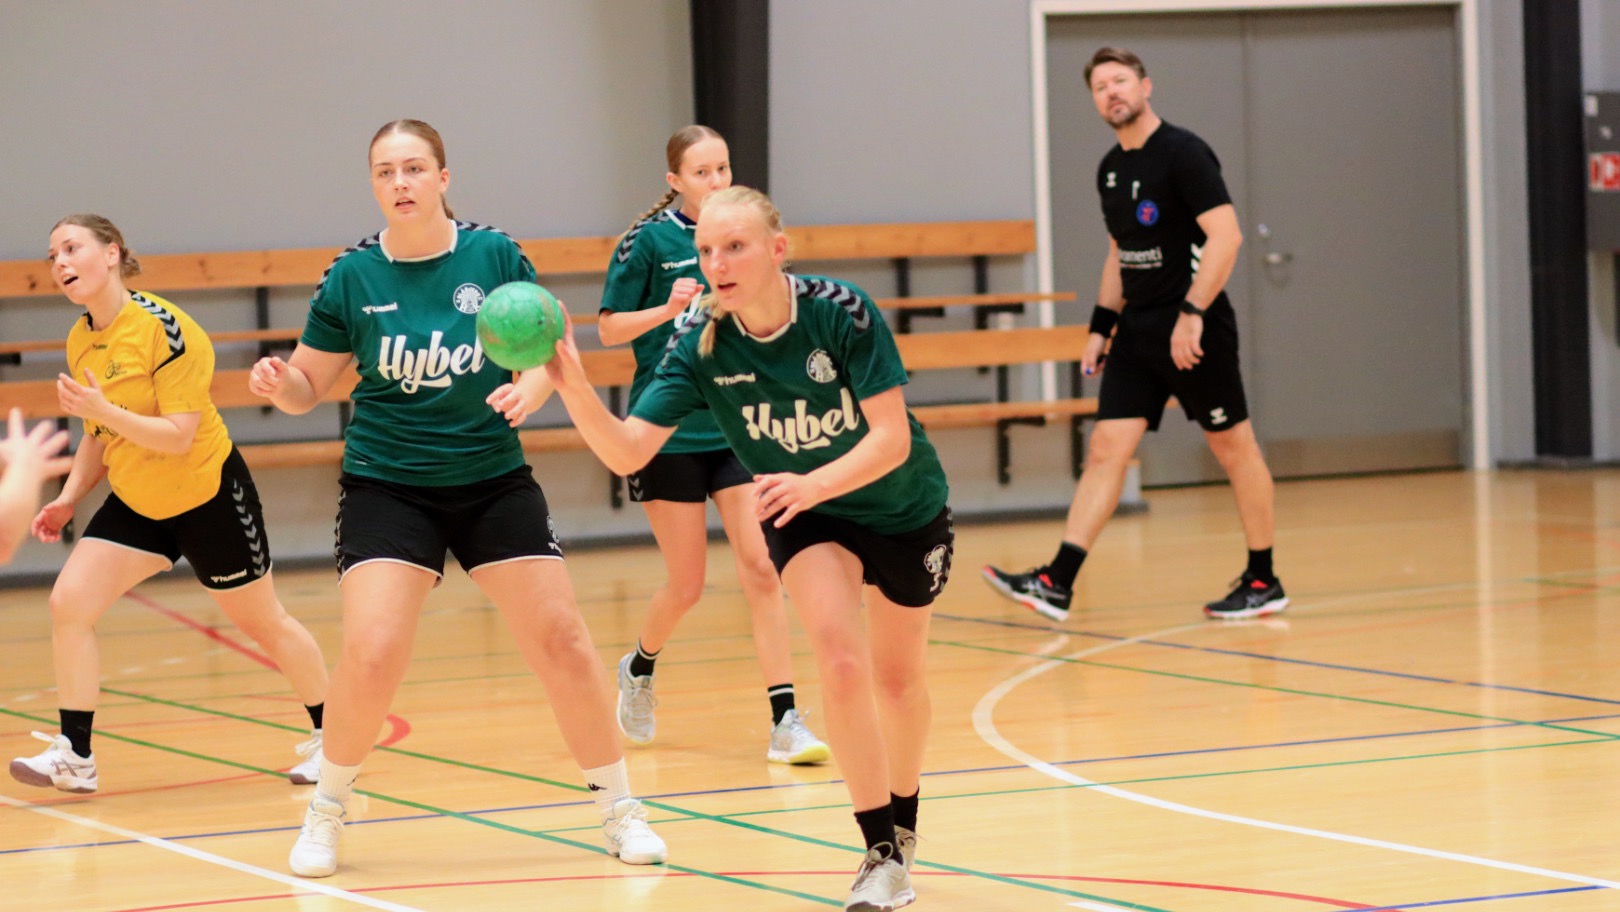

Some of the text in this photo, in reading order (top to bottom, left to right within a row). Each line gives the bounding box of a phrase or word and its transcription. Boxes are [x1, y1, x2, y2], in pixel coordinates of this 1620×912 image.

[377, 330, 486, 394] Hybel
[741, 387, 860, 454] Hybel
[219, 568, 248, 583] hummel
